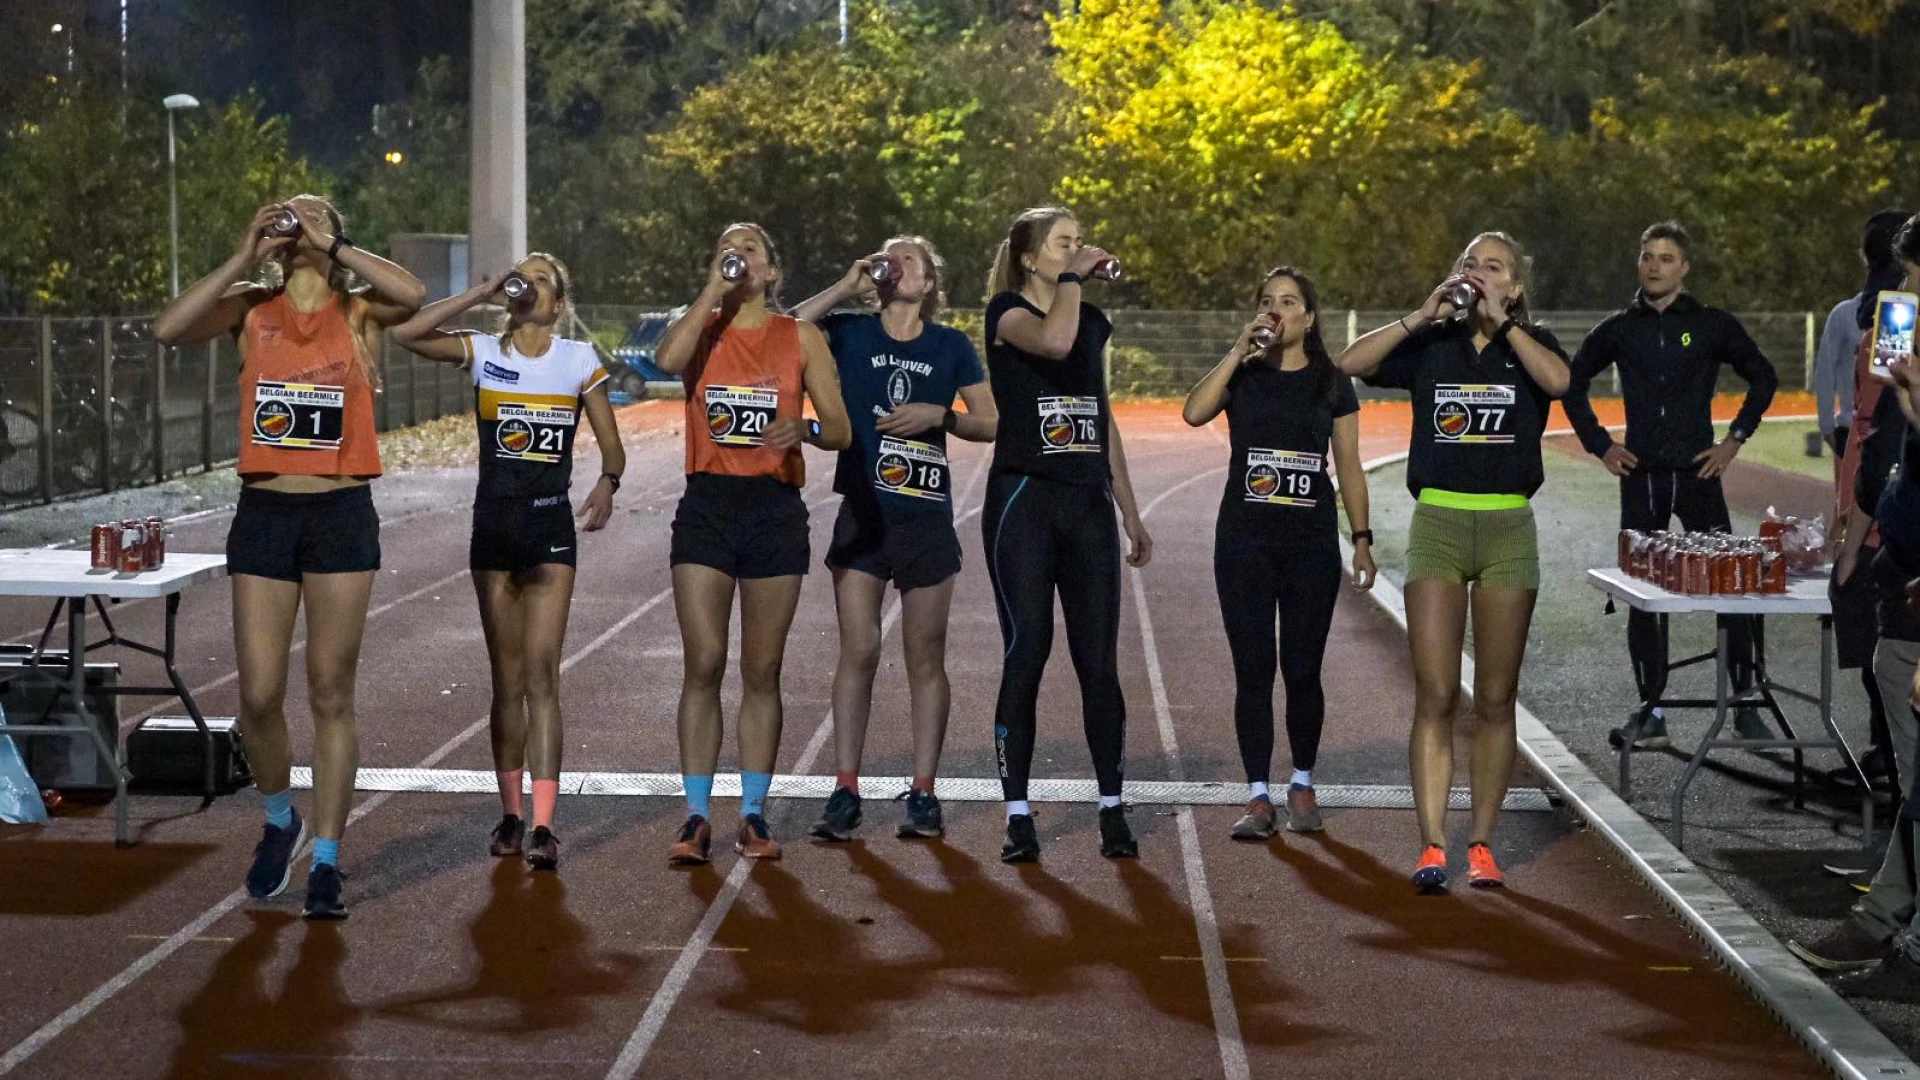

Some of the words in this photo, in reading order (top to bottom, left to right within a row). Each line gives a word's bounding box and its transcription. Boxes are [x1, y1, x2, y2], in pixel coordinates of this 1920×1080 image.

[871, 353, 887, 368] KU
[260, 388, 295, 398] BELGIAN
[297, 390, 340, 401] BEERMILE
[707, 391, 736, 399] BELGIAN
[738, 393, 774, 402] BEERMILE
[1437, 390, 1470, 398] BELGIAN
[1472, 391, 1511, 399] BEERMILE
[500, 408, 534, 417] BELGIAN
[536, 411, 572, 419] BEERMILE
[1477, 409, 1506, 431] 77
[310, 411, 321, 435] 1
[741, 410, 768, 434] 20
[1078, 419, 1096, 440] 76
[539, 428, 564, 451] 21
[883, 442, 915, 454] BELGIAN
[1250, 454, 1281, 462] BELGIAN
[1283, 456, 1318, 466] BEERMILE
[918, 465, 941, 488] 18
[1287, 473, 1311, 495] 19
[534, 496, 559, 507] NIKE
